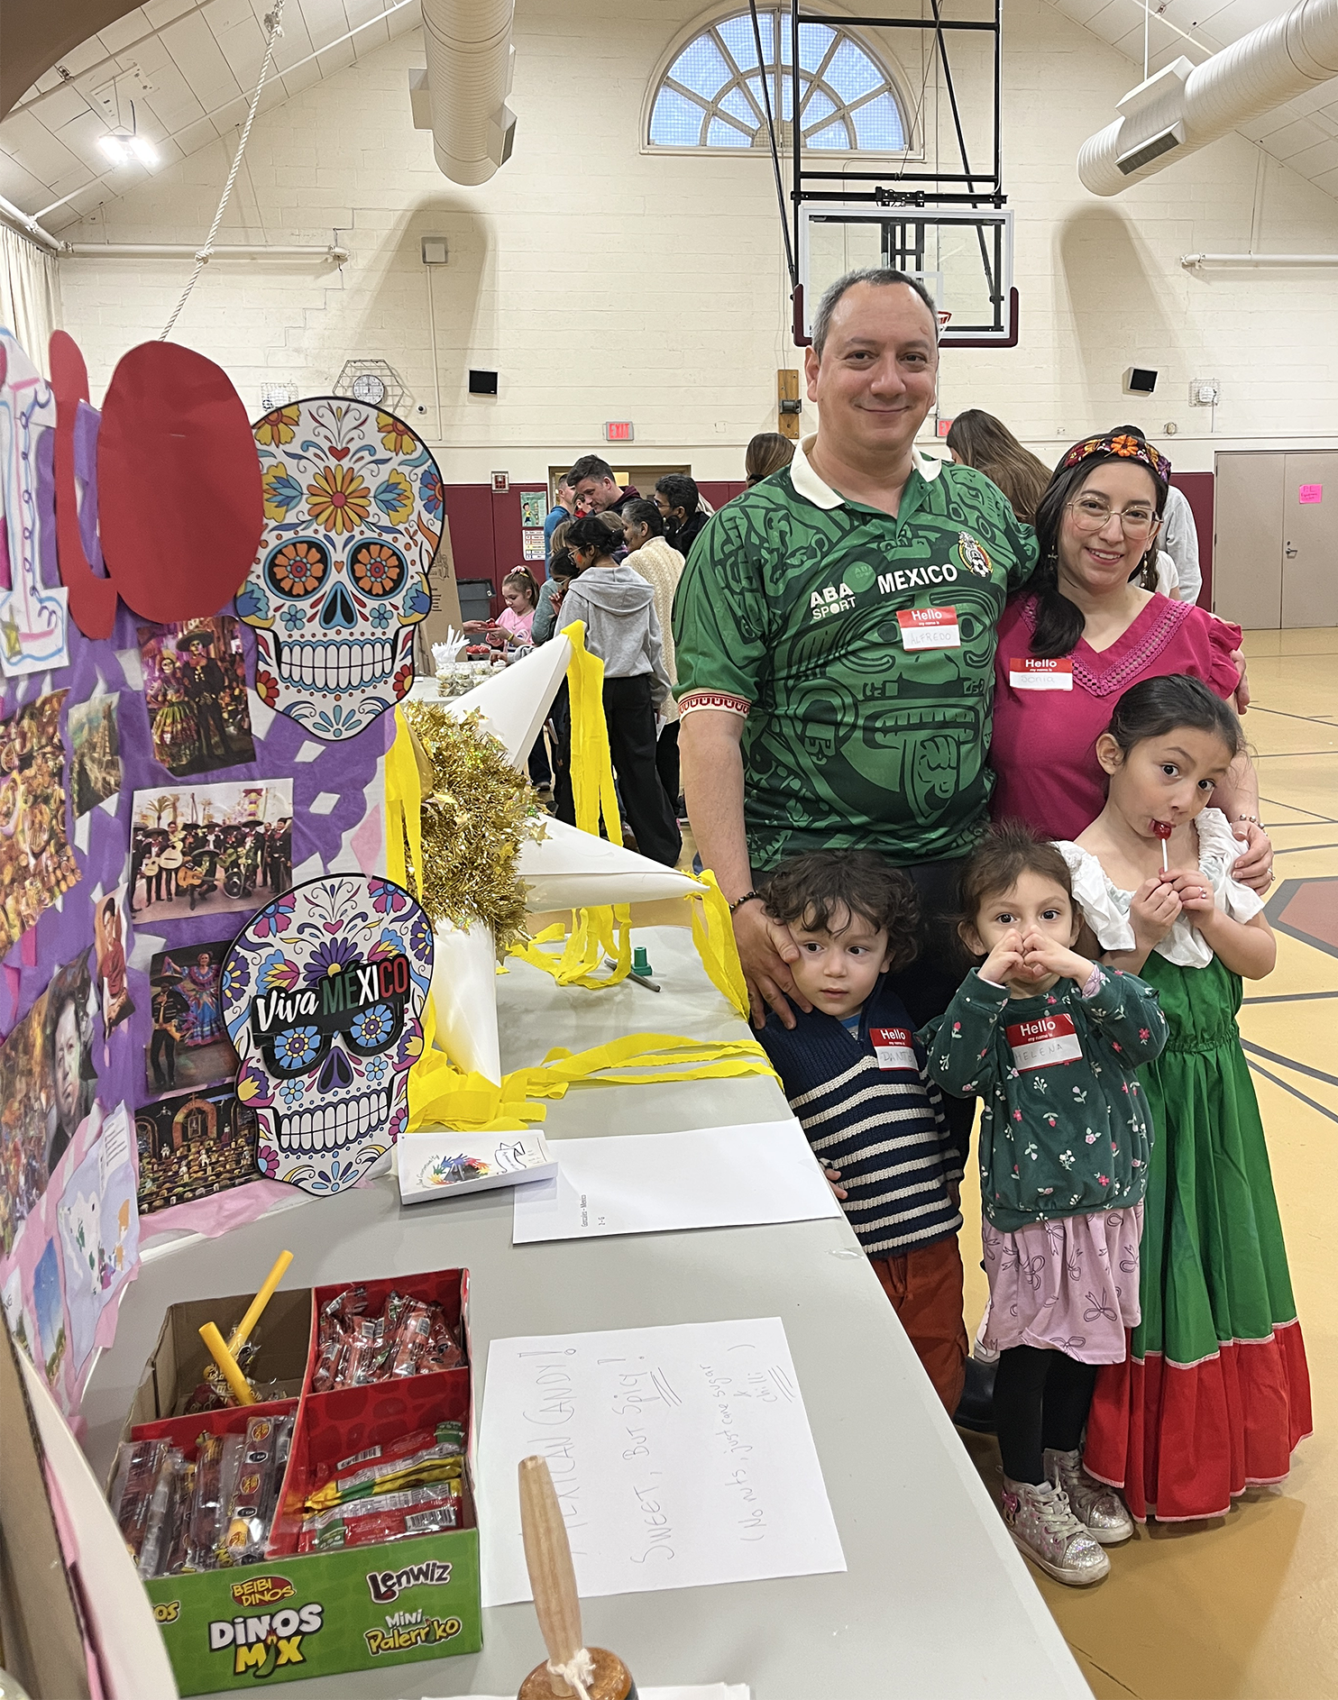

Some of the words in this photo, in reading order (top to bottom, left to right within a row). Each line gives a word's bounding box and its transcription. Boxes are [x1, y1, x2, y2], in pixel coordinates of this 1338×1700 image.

[608, 423, 630, 439] EXIT
[877, 563, 958, 594] MEXICO
[810, 582, 854, 608] ABA
[812, 597, 856, 620] SPORT
[911, 608, 942, 620] Hello
[1025, 658, 1058, 668] Hello
[256, 989, 319, 1032] Viva
[321, 956, 409, 1016] MÉXICO
[880, 1029, 906, 1040] Hello
[1019, 1019, 1056, 1037] Hello
[699, 1364, 733, 1398] sugar
[715, 1430, 752, 1454] just
[233, 1578, 272, 1597] BEIBI
[367, 1561, 451, 1601] Lenwiz
[241, 1585, 295, 1607] DINOS
